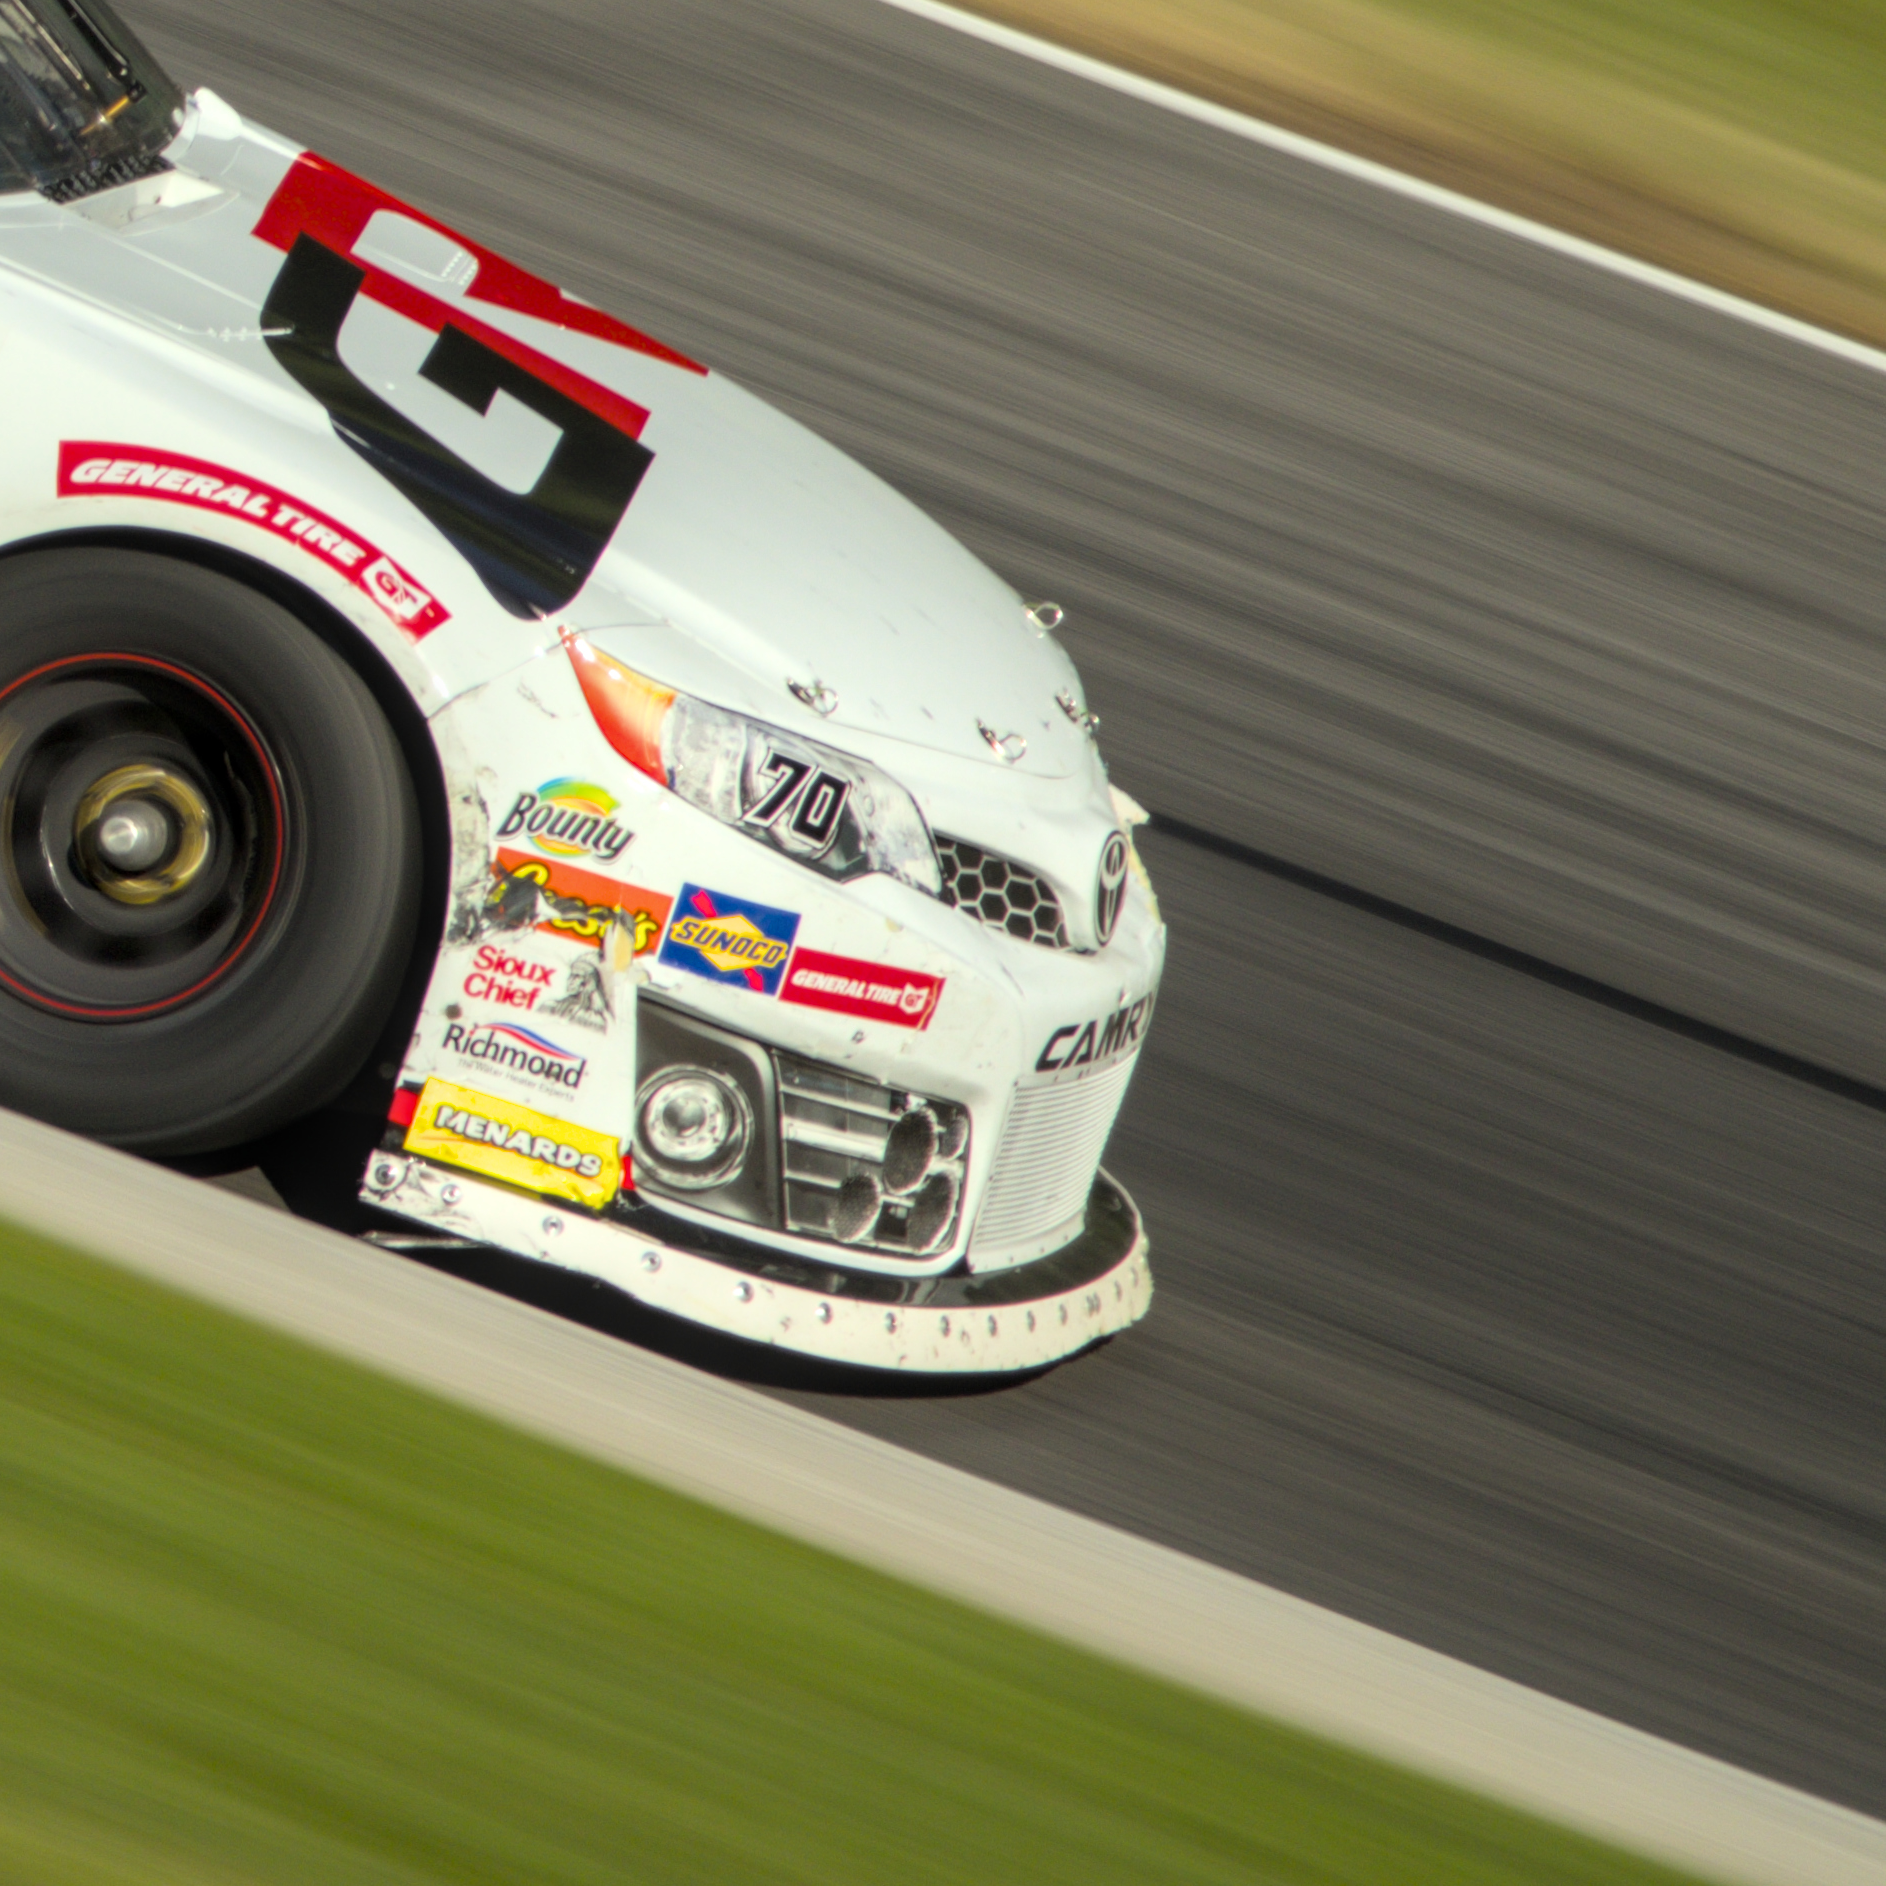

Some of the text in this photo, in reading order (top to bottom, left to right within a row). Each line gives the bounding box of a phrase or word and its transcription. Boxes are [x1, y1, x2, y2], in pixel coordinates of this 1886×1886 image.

[70, 458, 270, 518] GENERAL
[270, 505, 367, 566] TIRE
[495, 792, 635, 862] Bounty
[742, 747, 852, 850] 70
[473, 945, 556, 987] Sioux
[676, 920, 784, 964] SUNOCO
[463, 973, 541, 1011] Chief
[791, 969, 865, 999] GENERAL
[863, 983, 903, 1007] TIRE
[442, 1023, 587, 1089] Richmond
[434, 1104, 603, 1178] MENARDS
